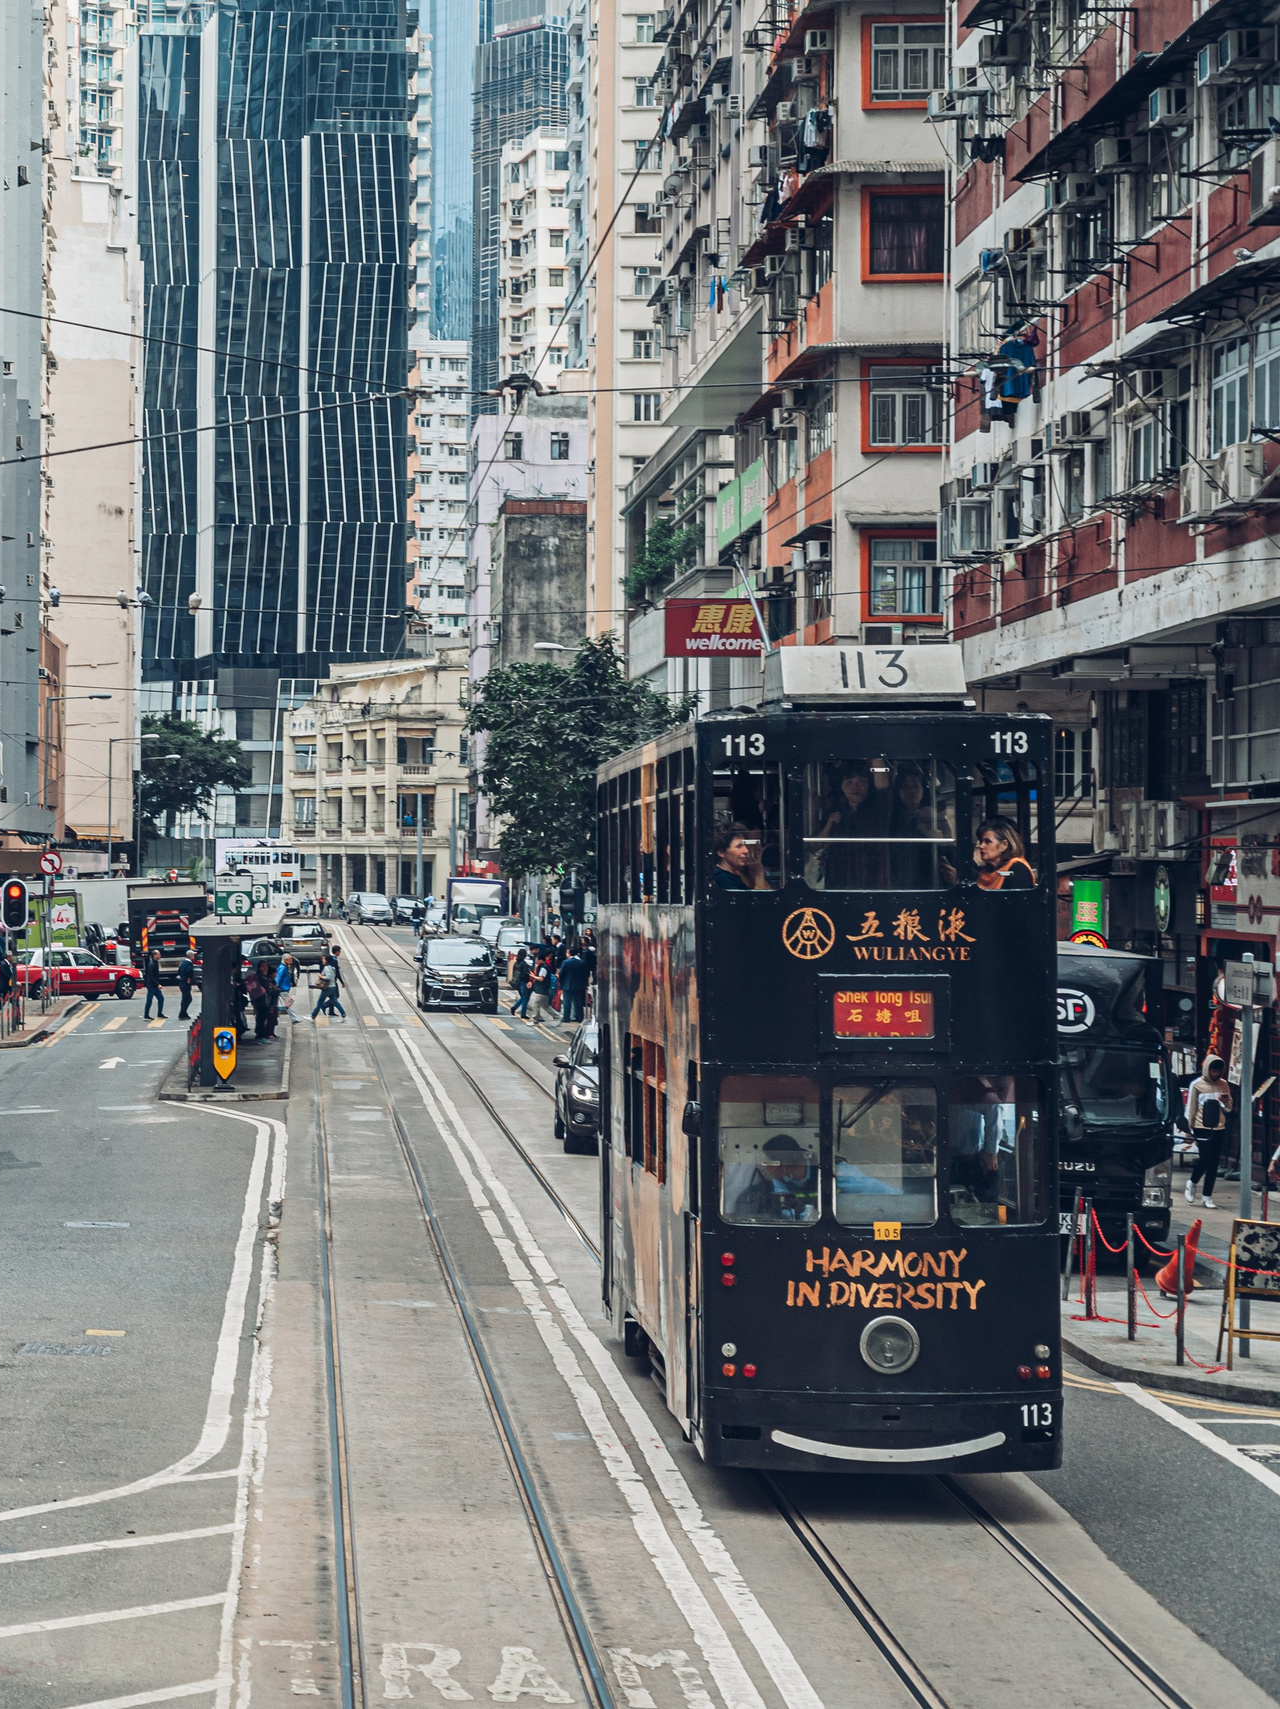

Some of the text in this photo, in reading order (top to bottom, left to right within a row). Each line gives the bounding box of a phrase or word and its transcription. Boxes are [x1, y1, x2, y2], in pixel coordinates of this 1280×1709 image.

[692, 604, 755, 633] 惠康
[686, 634, 762, 651] wellcome
[839, 650, 908, 689] 113
[721, 733, 765, 756] 113
[990, 731, 1029, 754] 113
[846, 908, 977, 942] 五粮液
[853, 947, 970, 961] WULIANGYE
[837, 992, 869, 1004] Shek
[847, 1008, 922, 1023] 石塘咀
[877, 1228, 899, 1239] 105
[805, 1246, 968, 1279] HARMONY
[786, 1279, 986, 1310] IN DIVERSITY
[1020, 1403, 1053, 1427] 113
